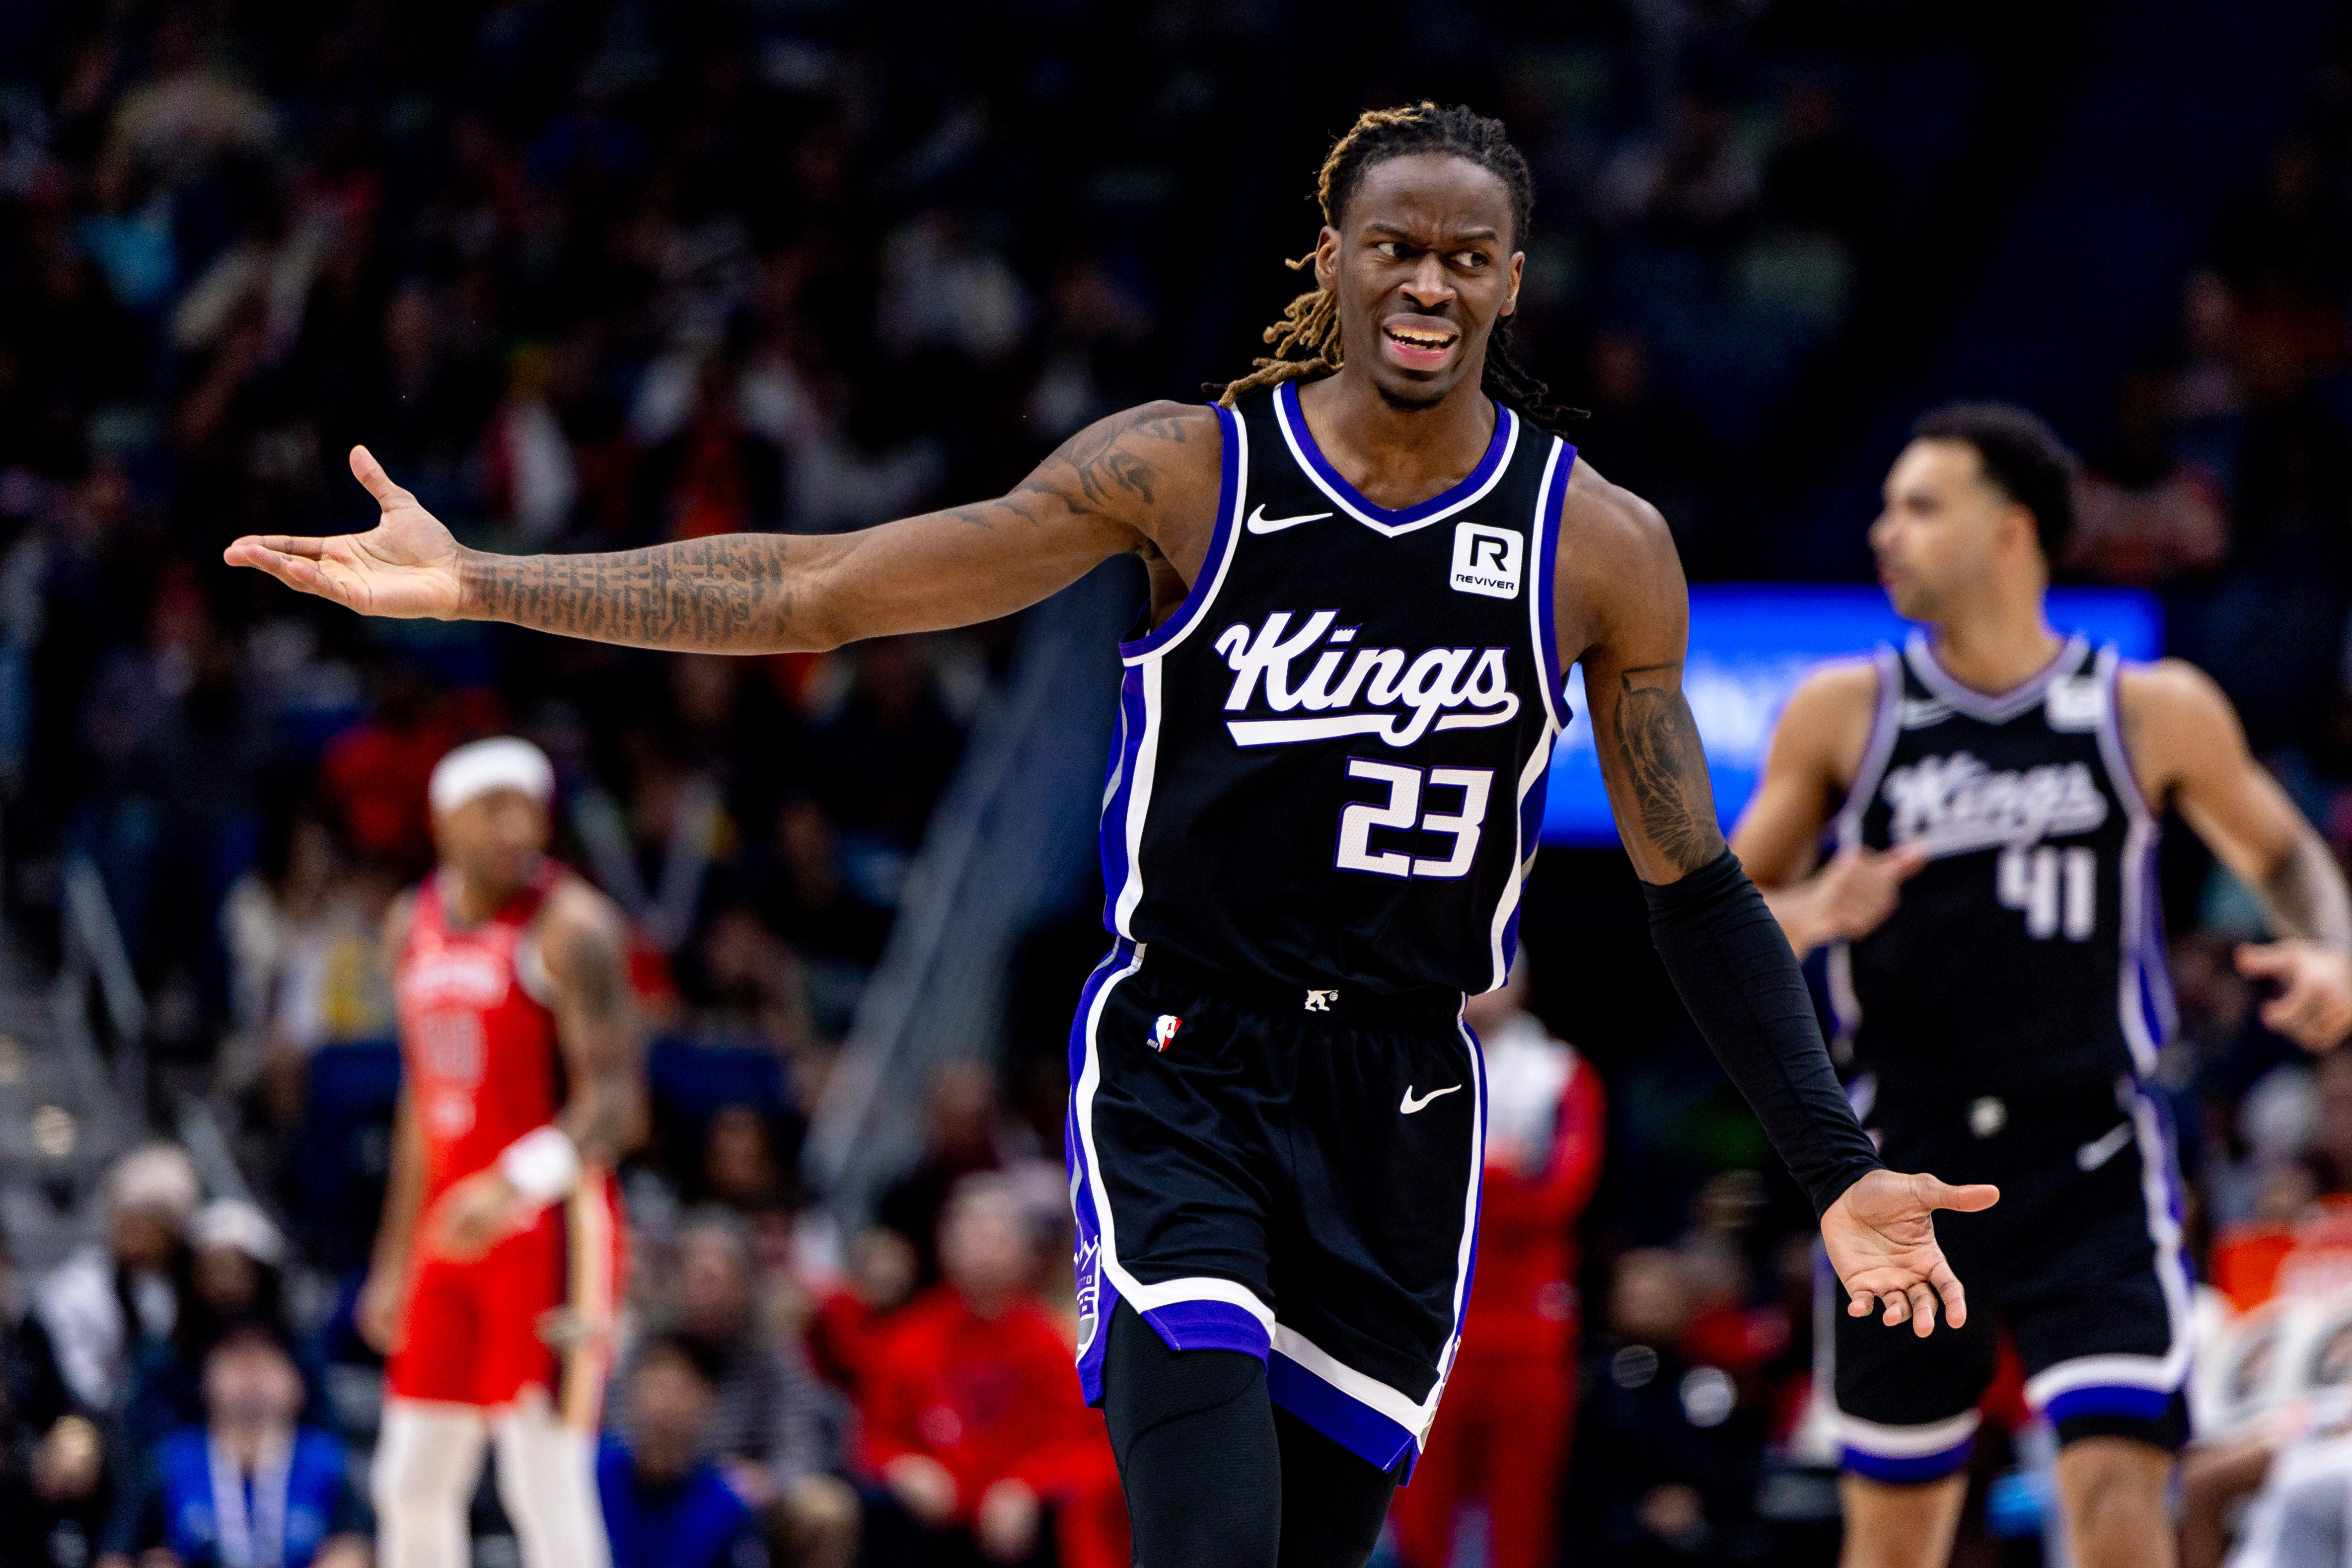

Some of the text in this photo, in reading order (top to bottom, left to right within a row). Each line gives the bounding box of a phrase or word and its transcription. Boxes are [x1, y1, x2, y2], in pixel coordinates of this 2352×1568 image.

[1456, 574, 1515, 591] REVIVER
[1469, 533, 1509, 572] R
[1212, 608, 1522, 748] Kings
[1332, 755, 1497, 882] 23
[1994, 843, 2097, 942] 41
